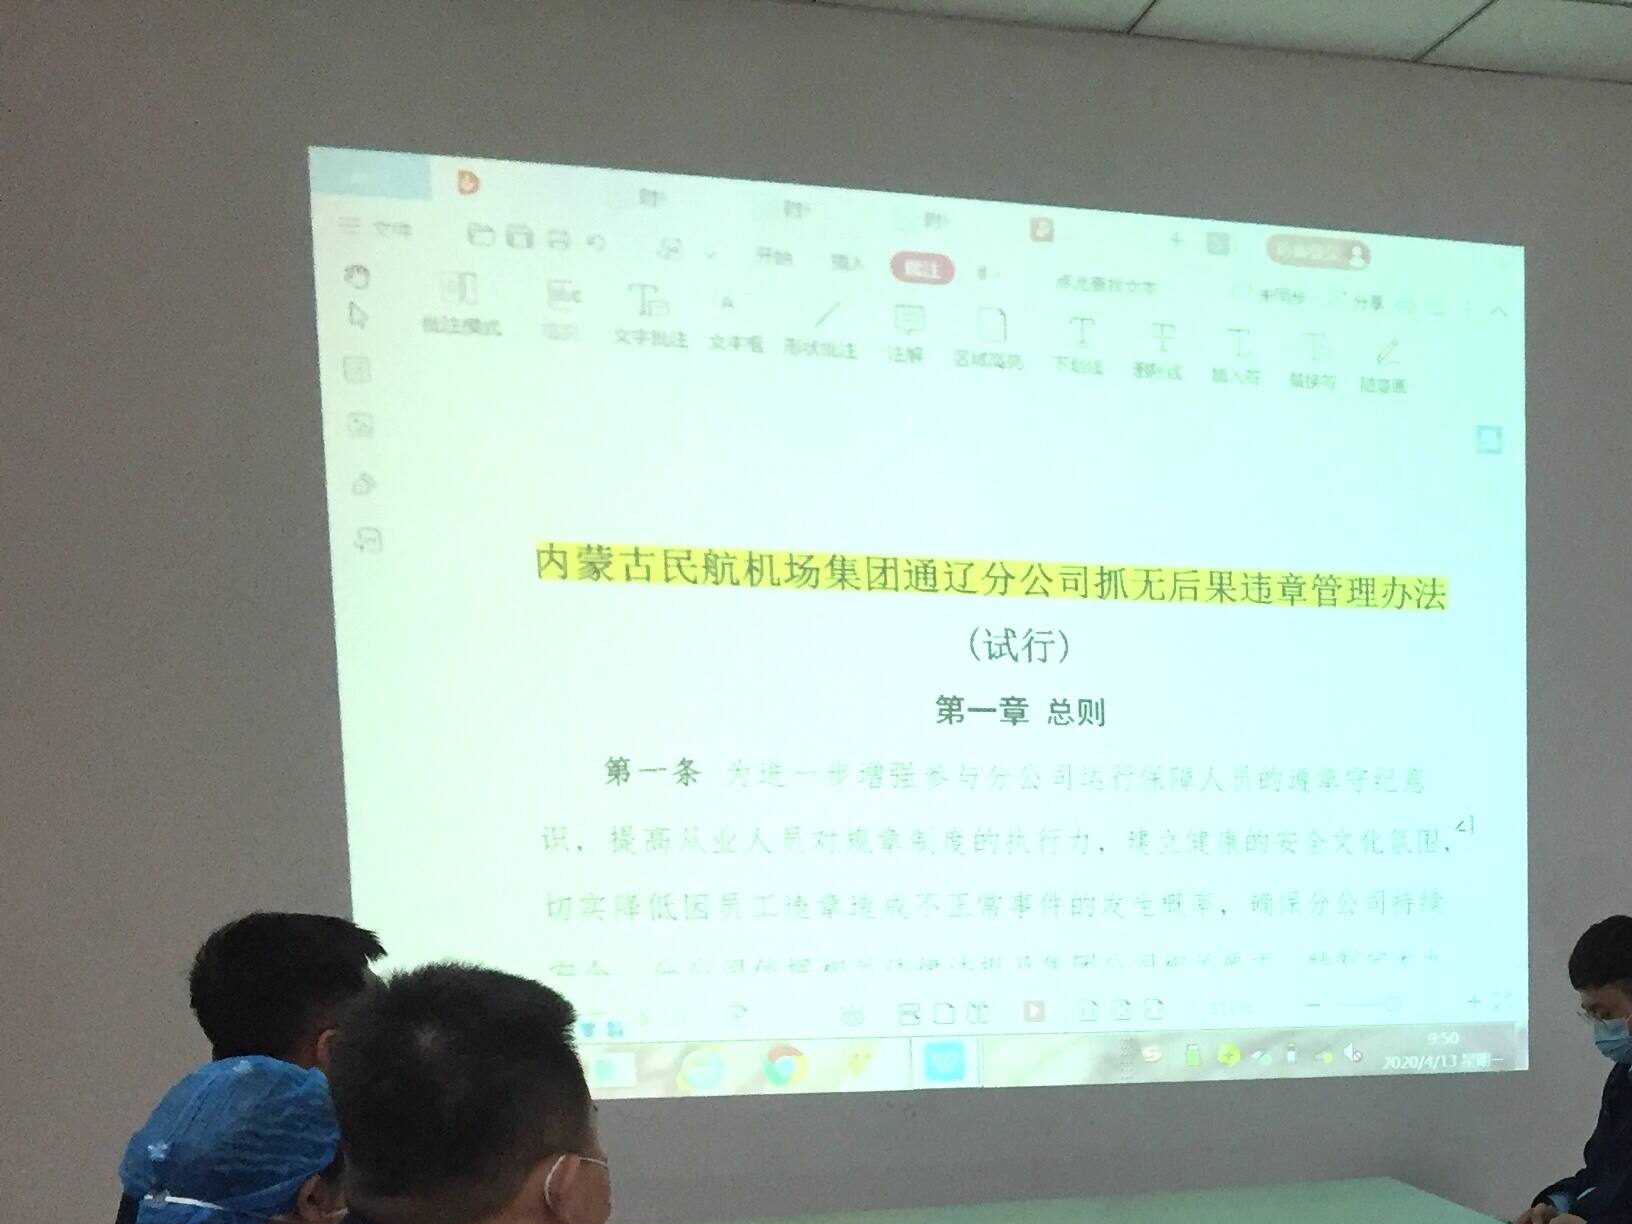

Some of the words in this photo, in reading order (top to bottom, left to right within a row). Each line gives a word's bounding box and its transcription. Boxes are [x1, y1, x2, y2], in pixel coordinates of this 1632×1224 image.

[536, 543, 1447, 611] 内蒙古民航机场集团通辽分公司抓无后果违章管理办法
[968, 627, 1070, 664] （试行）
[935, 695, 1030, 727] 第一章
[1047, 697, 1106, 728] 总则
[604, 756, 702, 787] 第一条
[1426, 1030, 1461, 1047] 9:50
[1381, 1053, 1458, 1071] 2020/4/13
